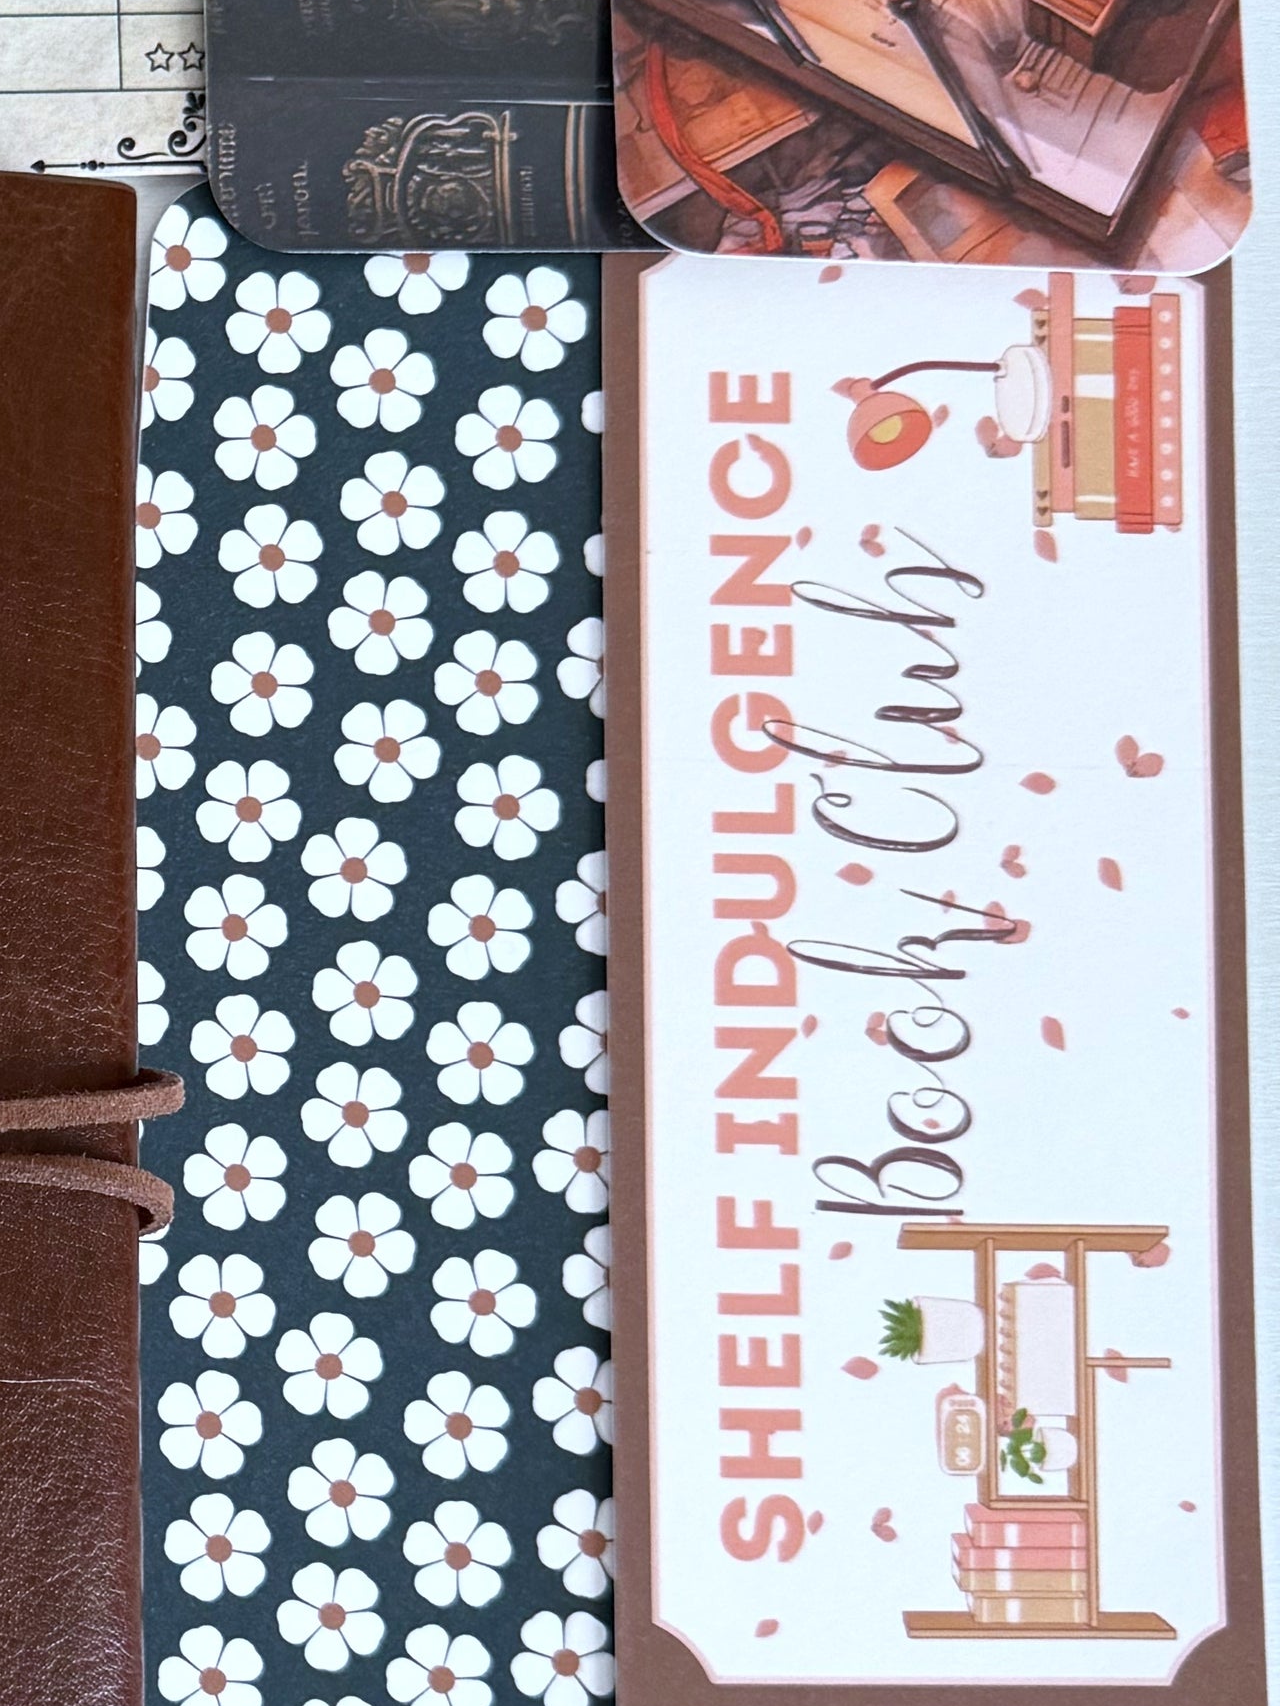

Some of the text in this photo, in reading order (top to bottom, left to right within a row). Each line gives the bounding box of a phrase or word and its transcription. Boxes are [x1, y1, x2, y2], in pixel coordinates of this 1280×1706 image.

[708, 370, 805, 1564] SHELF INDULGENCE
[762, 525, 1017, 1216] Book Club
